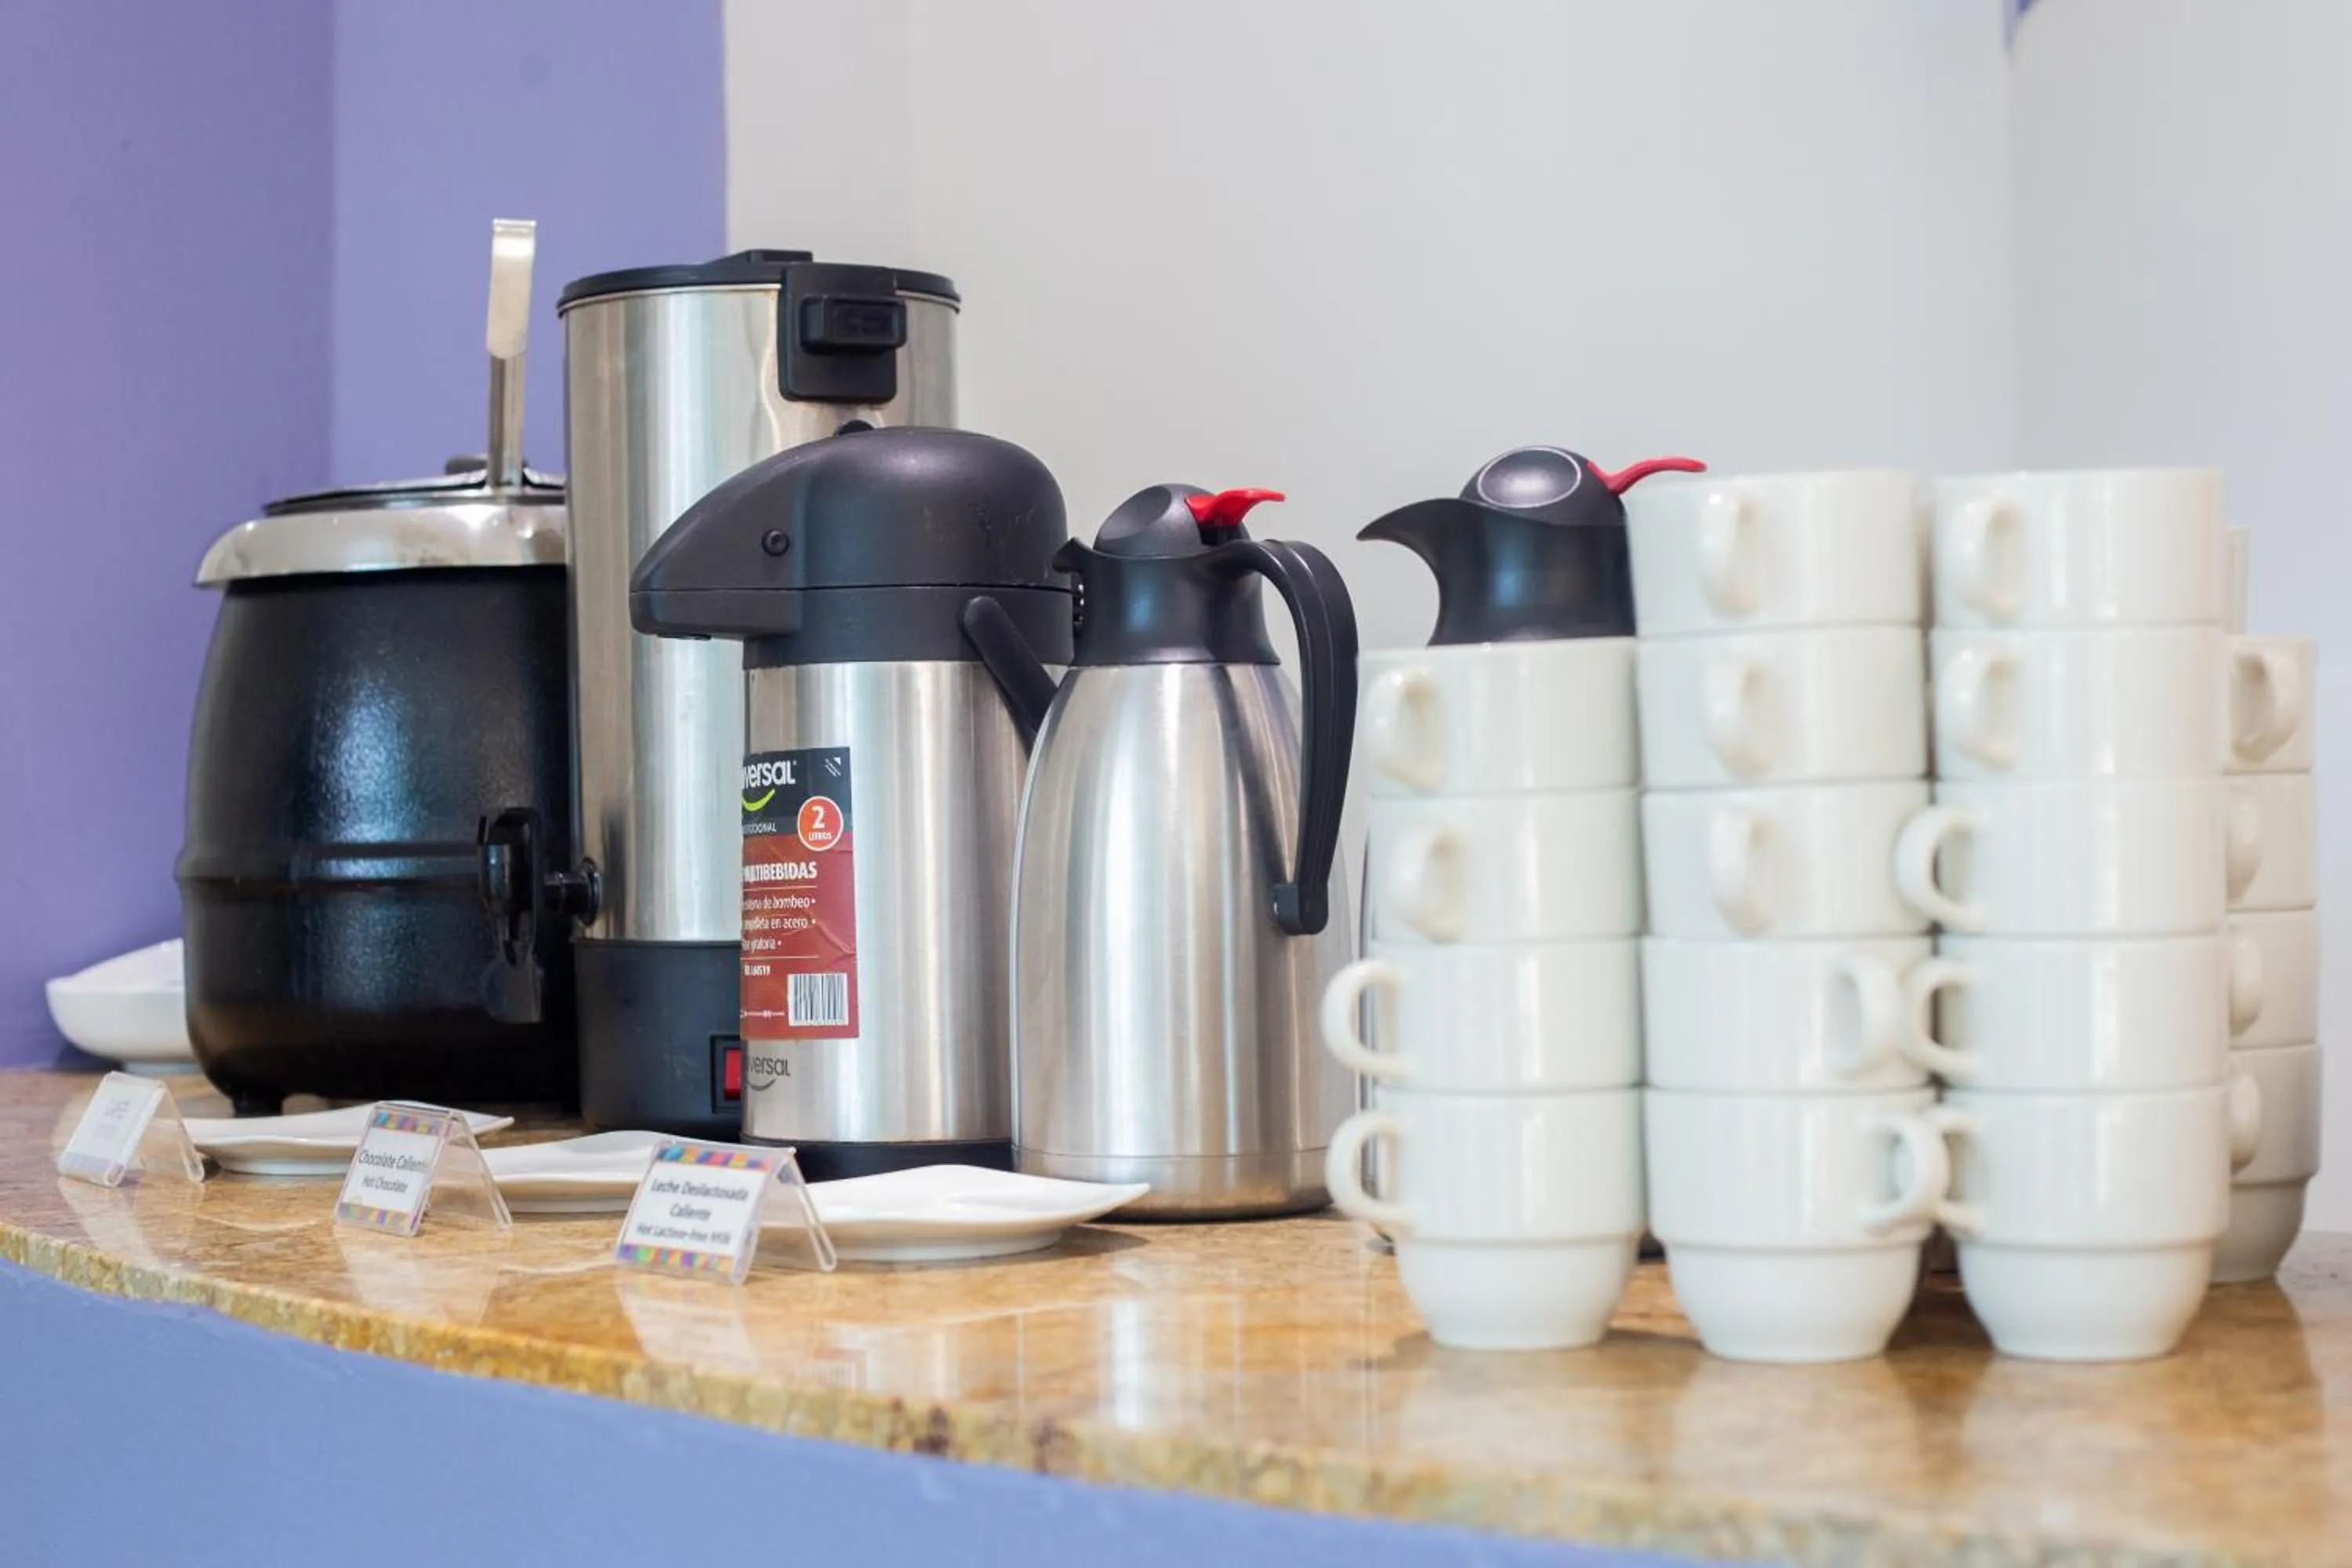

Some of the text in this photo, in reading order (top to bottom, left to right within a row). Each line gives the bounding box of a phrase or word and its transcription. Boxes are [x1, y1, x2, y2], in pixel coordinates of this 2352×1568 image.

[811, 806, 825, 829] 2
[809, 831, 832, 841] LITROS
[772, 895, 810, 909] bombeo
[771, 918, 782, 929] en
[782, 917, 808, 929] acero
[358, 1149, 395, 1168] Chocolate
[362, 1176, 408, 1194] Hot Chocolate
[652, 1178, 680, 1192] Leche
[669, 1203, 712, 1221] Caliente
